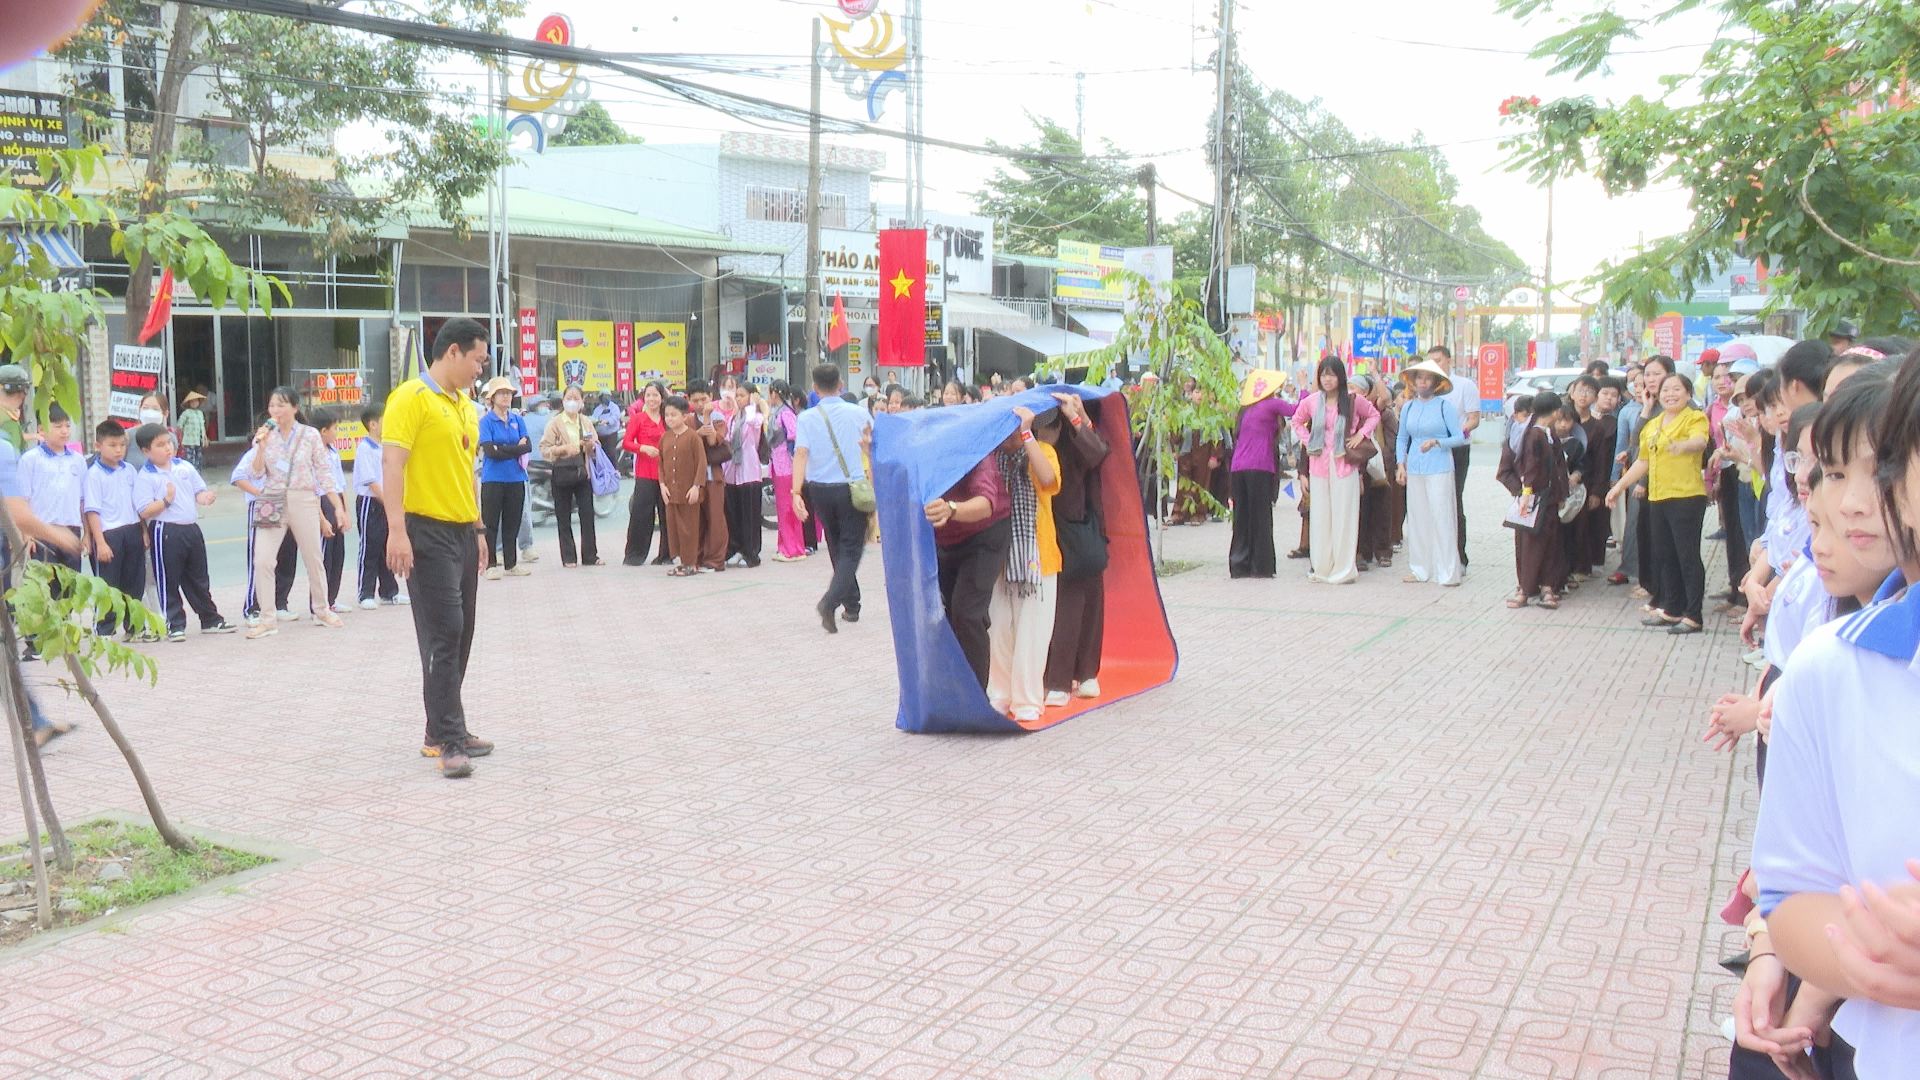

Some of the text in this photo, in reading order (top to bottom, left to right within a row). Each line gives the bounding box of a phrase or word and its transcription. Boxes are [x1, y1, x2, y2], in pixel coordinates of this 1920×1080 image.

[40, 99, 61, 116] XE
[47, 120, 63, 129] XE
[23, 131, 45, 143] ĐÈN
[49, 134, 67, 144] LED
